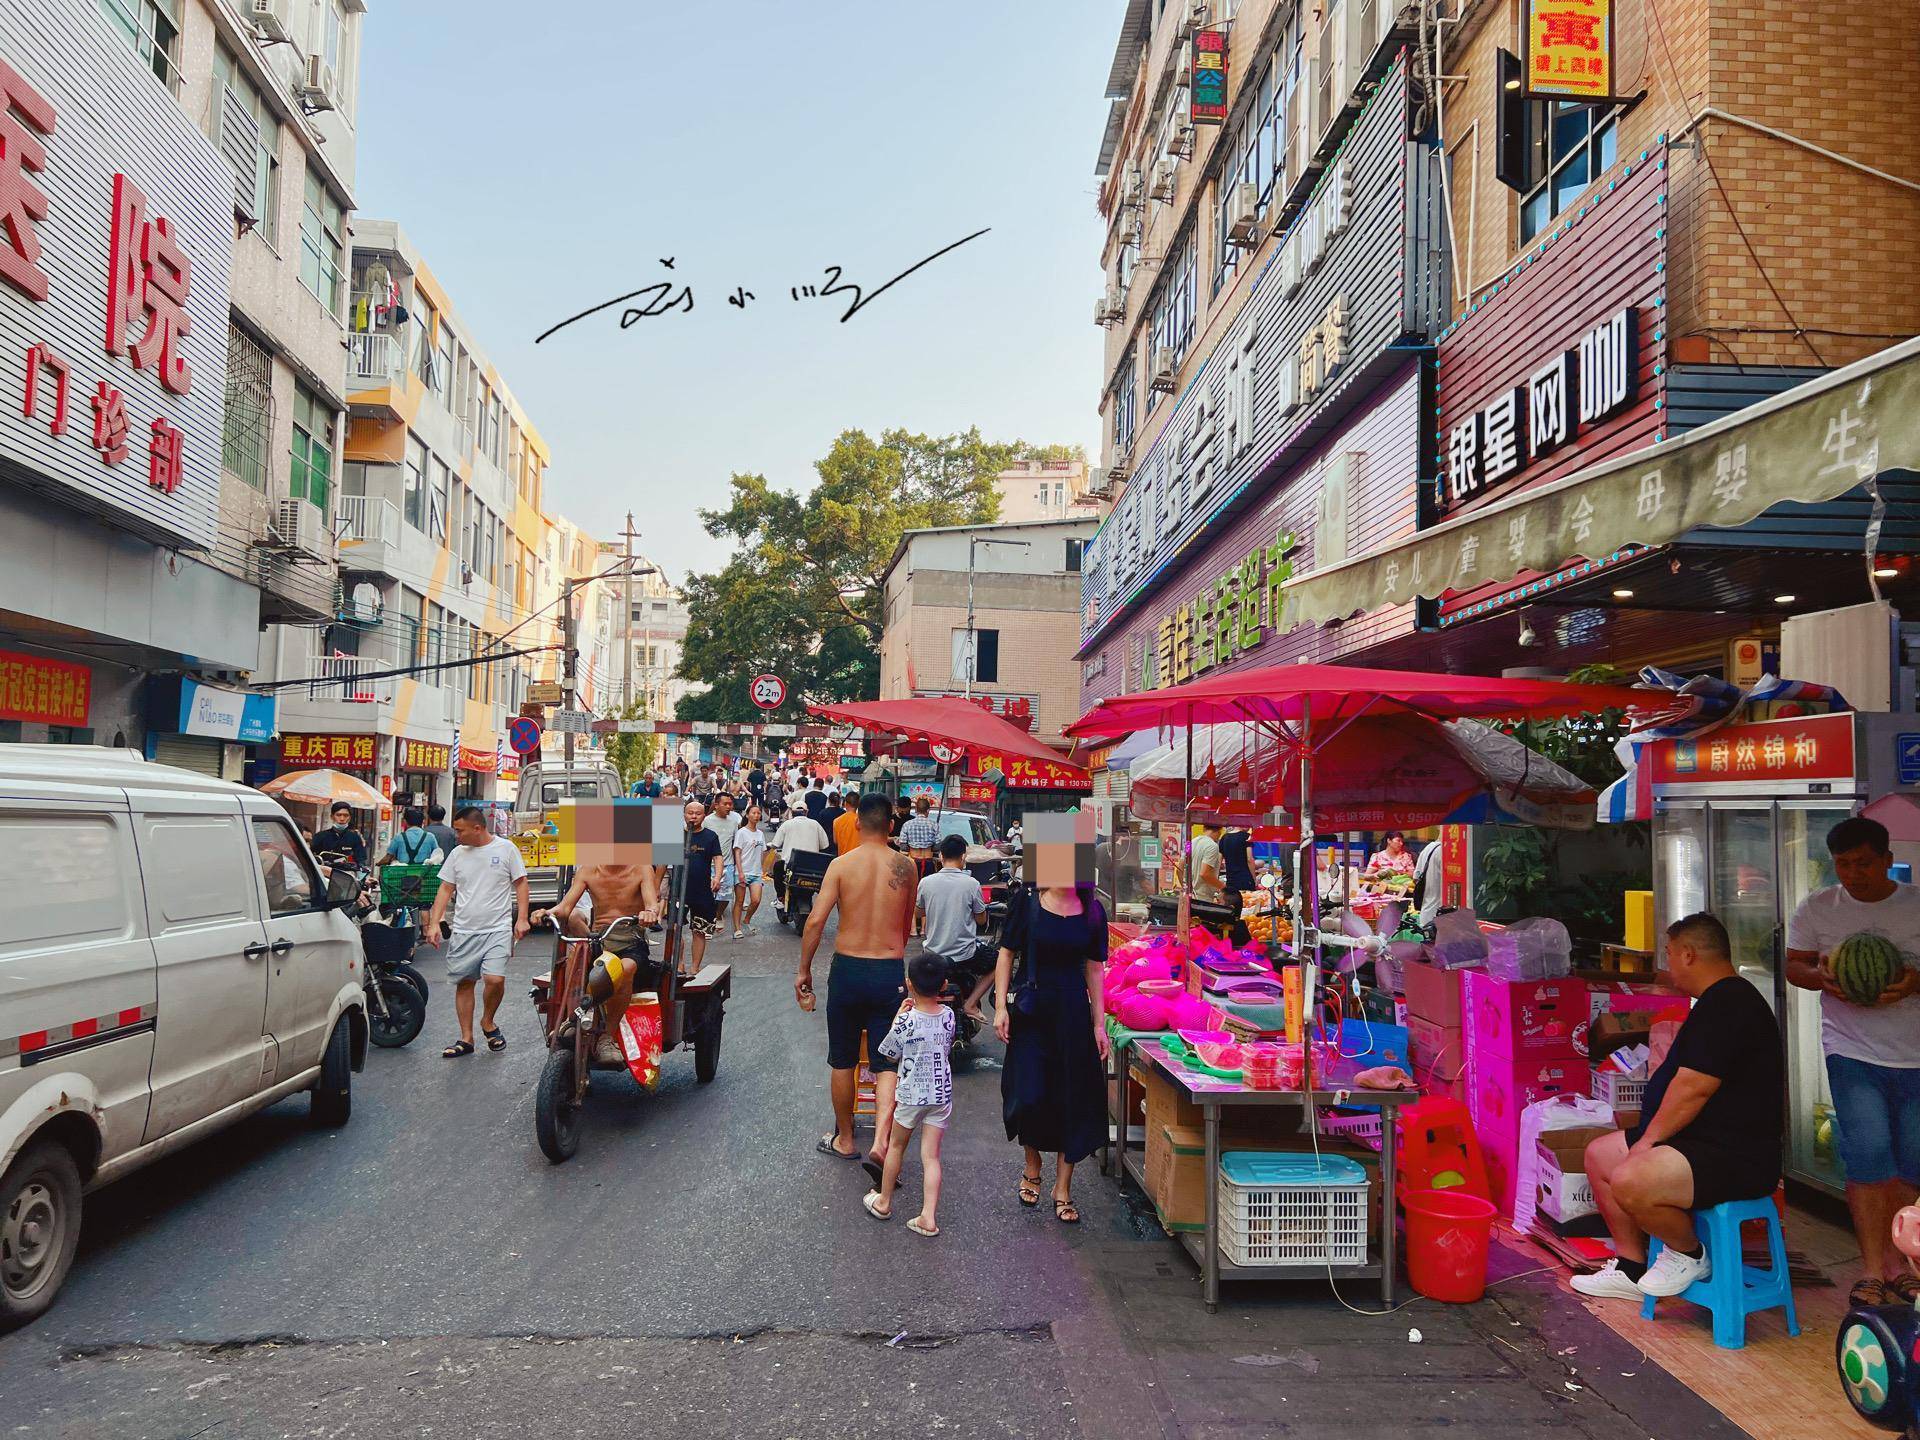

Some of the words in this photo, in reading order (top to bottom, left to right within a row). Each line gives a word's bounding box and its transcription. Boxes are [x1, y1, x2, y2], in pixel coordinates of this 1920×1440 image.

[23, 341, 187, 495] 门诊部
[1448, 306, 1630, 501] 银星网咖
[283, 735, 375, 760] 重庆面馆
[407, 741, 449, 770] 新重庆面馆
[1709, 732, 1817, 773] 蔚然锦和
[933, 1051, 943, 1104] BELIEVIN
